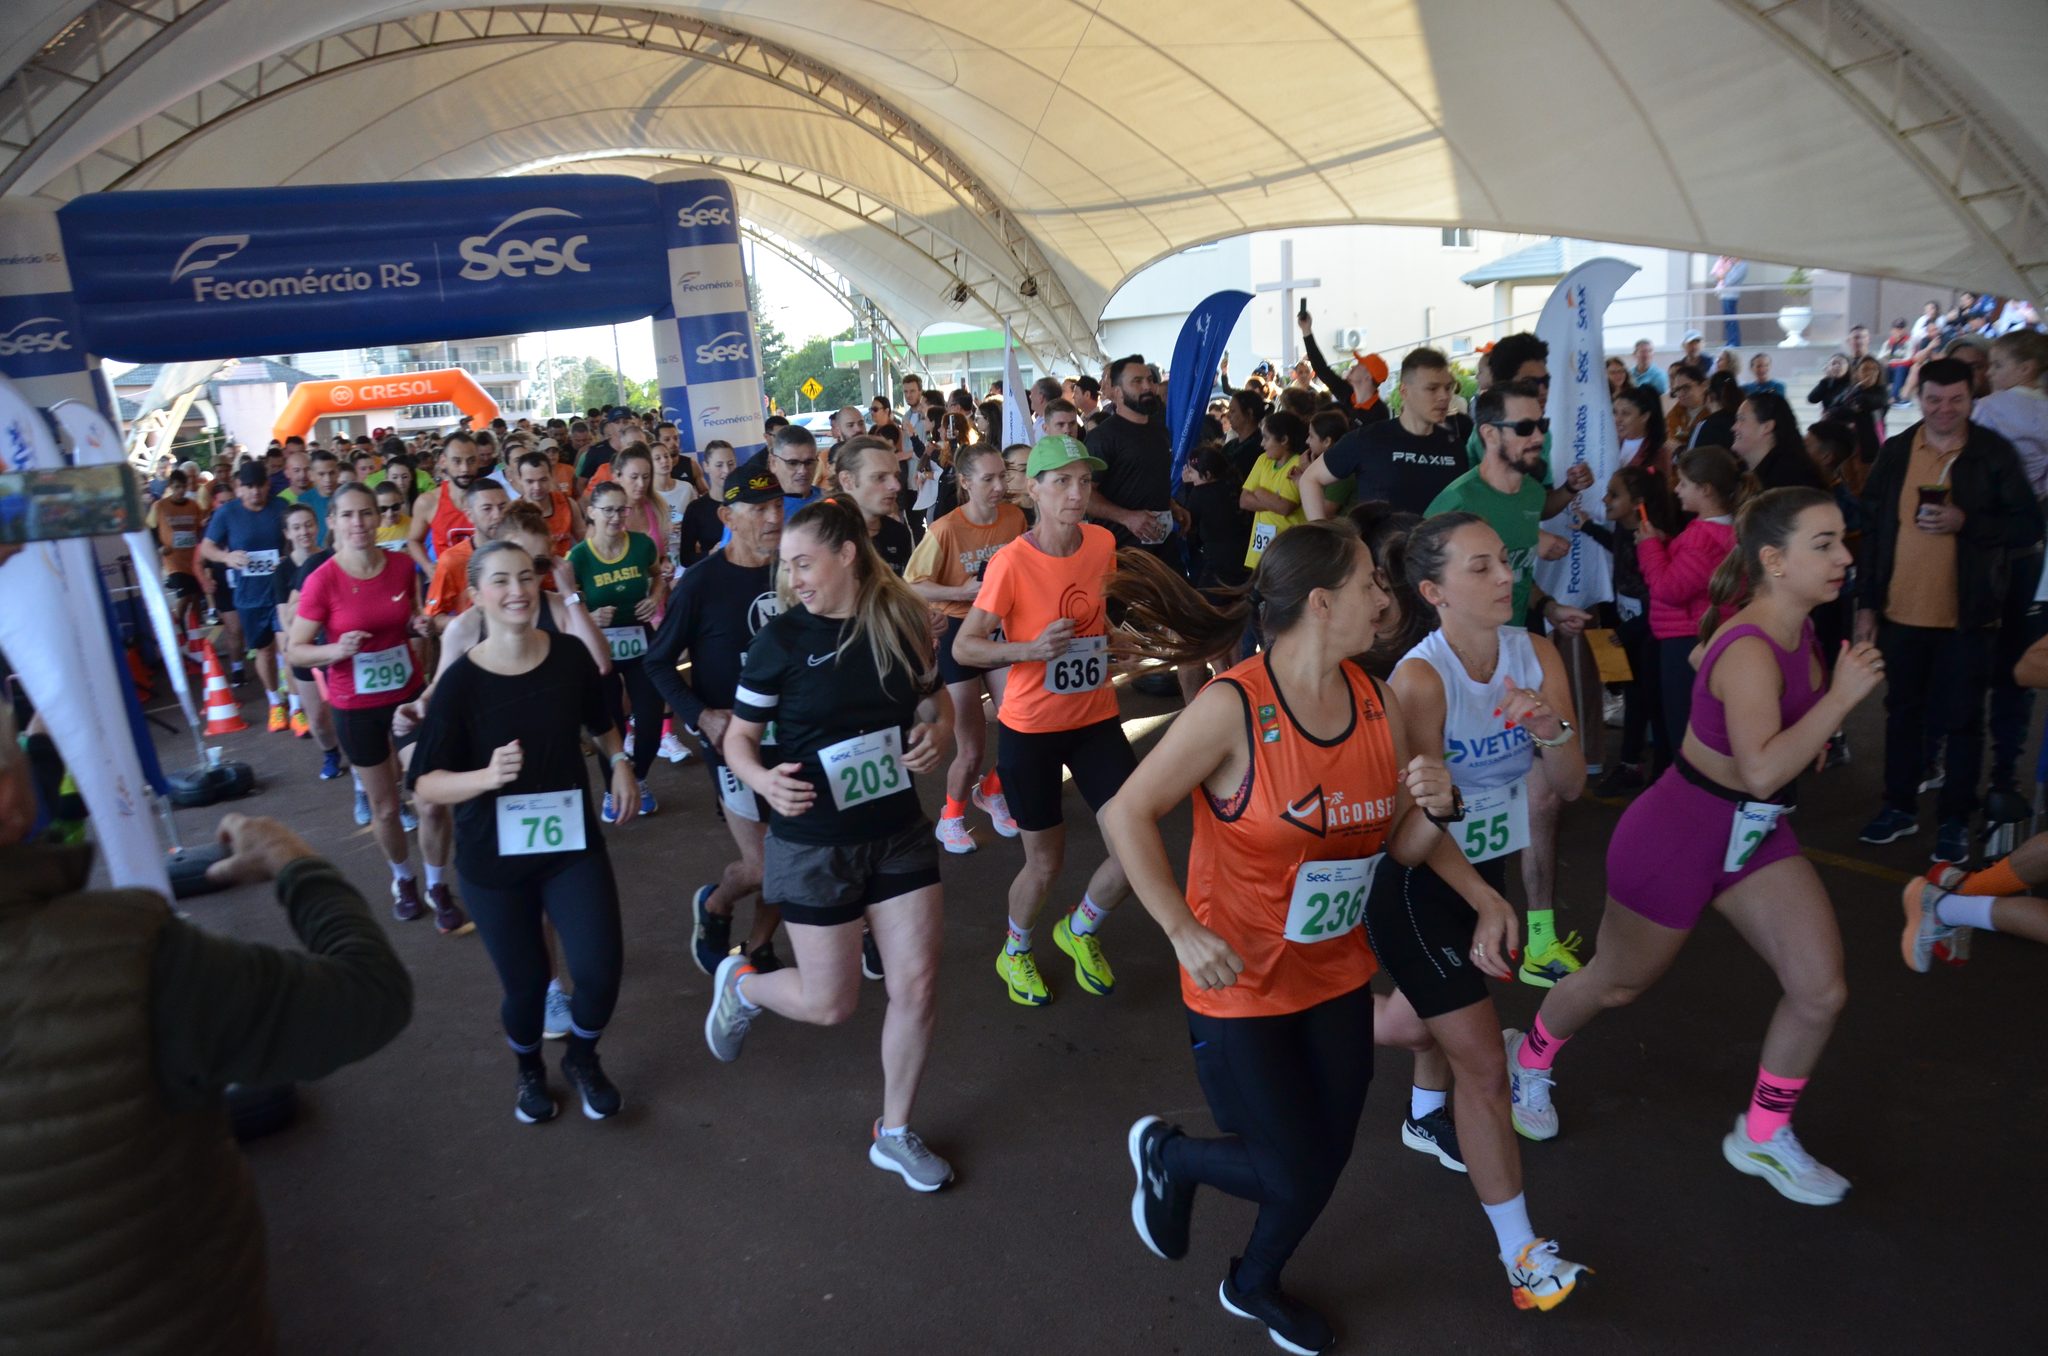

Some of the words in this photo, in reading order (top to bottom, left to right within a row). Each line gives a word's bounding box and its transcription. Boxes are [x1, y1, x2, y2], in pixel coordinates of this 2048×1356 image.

[192, 268, 372, 302] Fecomércio
[379, 262, 420, 289] RS
[683, 281, 734, 293] Fecomércio
[359, 379, 439, 401] CRESOL
[703, 414, 753, 428] Fecomércio
[1573, 404, 1588, 466] indicatos
[1392, 451, 1456, 467] PRAXIS
[593, 566, 642, 587] BRASIL
[363, 662, 406, 689] 299
[1054, 657, 1100, 690] 636
[840, 754, 900, 802] 203
[521, 815, 564, 848] 76
[1464, 812, 1510, 858] 55
[1300, 885, 1366, 936] 236
[1512, 1072, 1521, 1104] FILA
[1415, 1125, 1438, 1144] FILA
